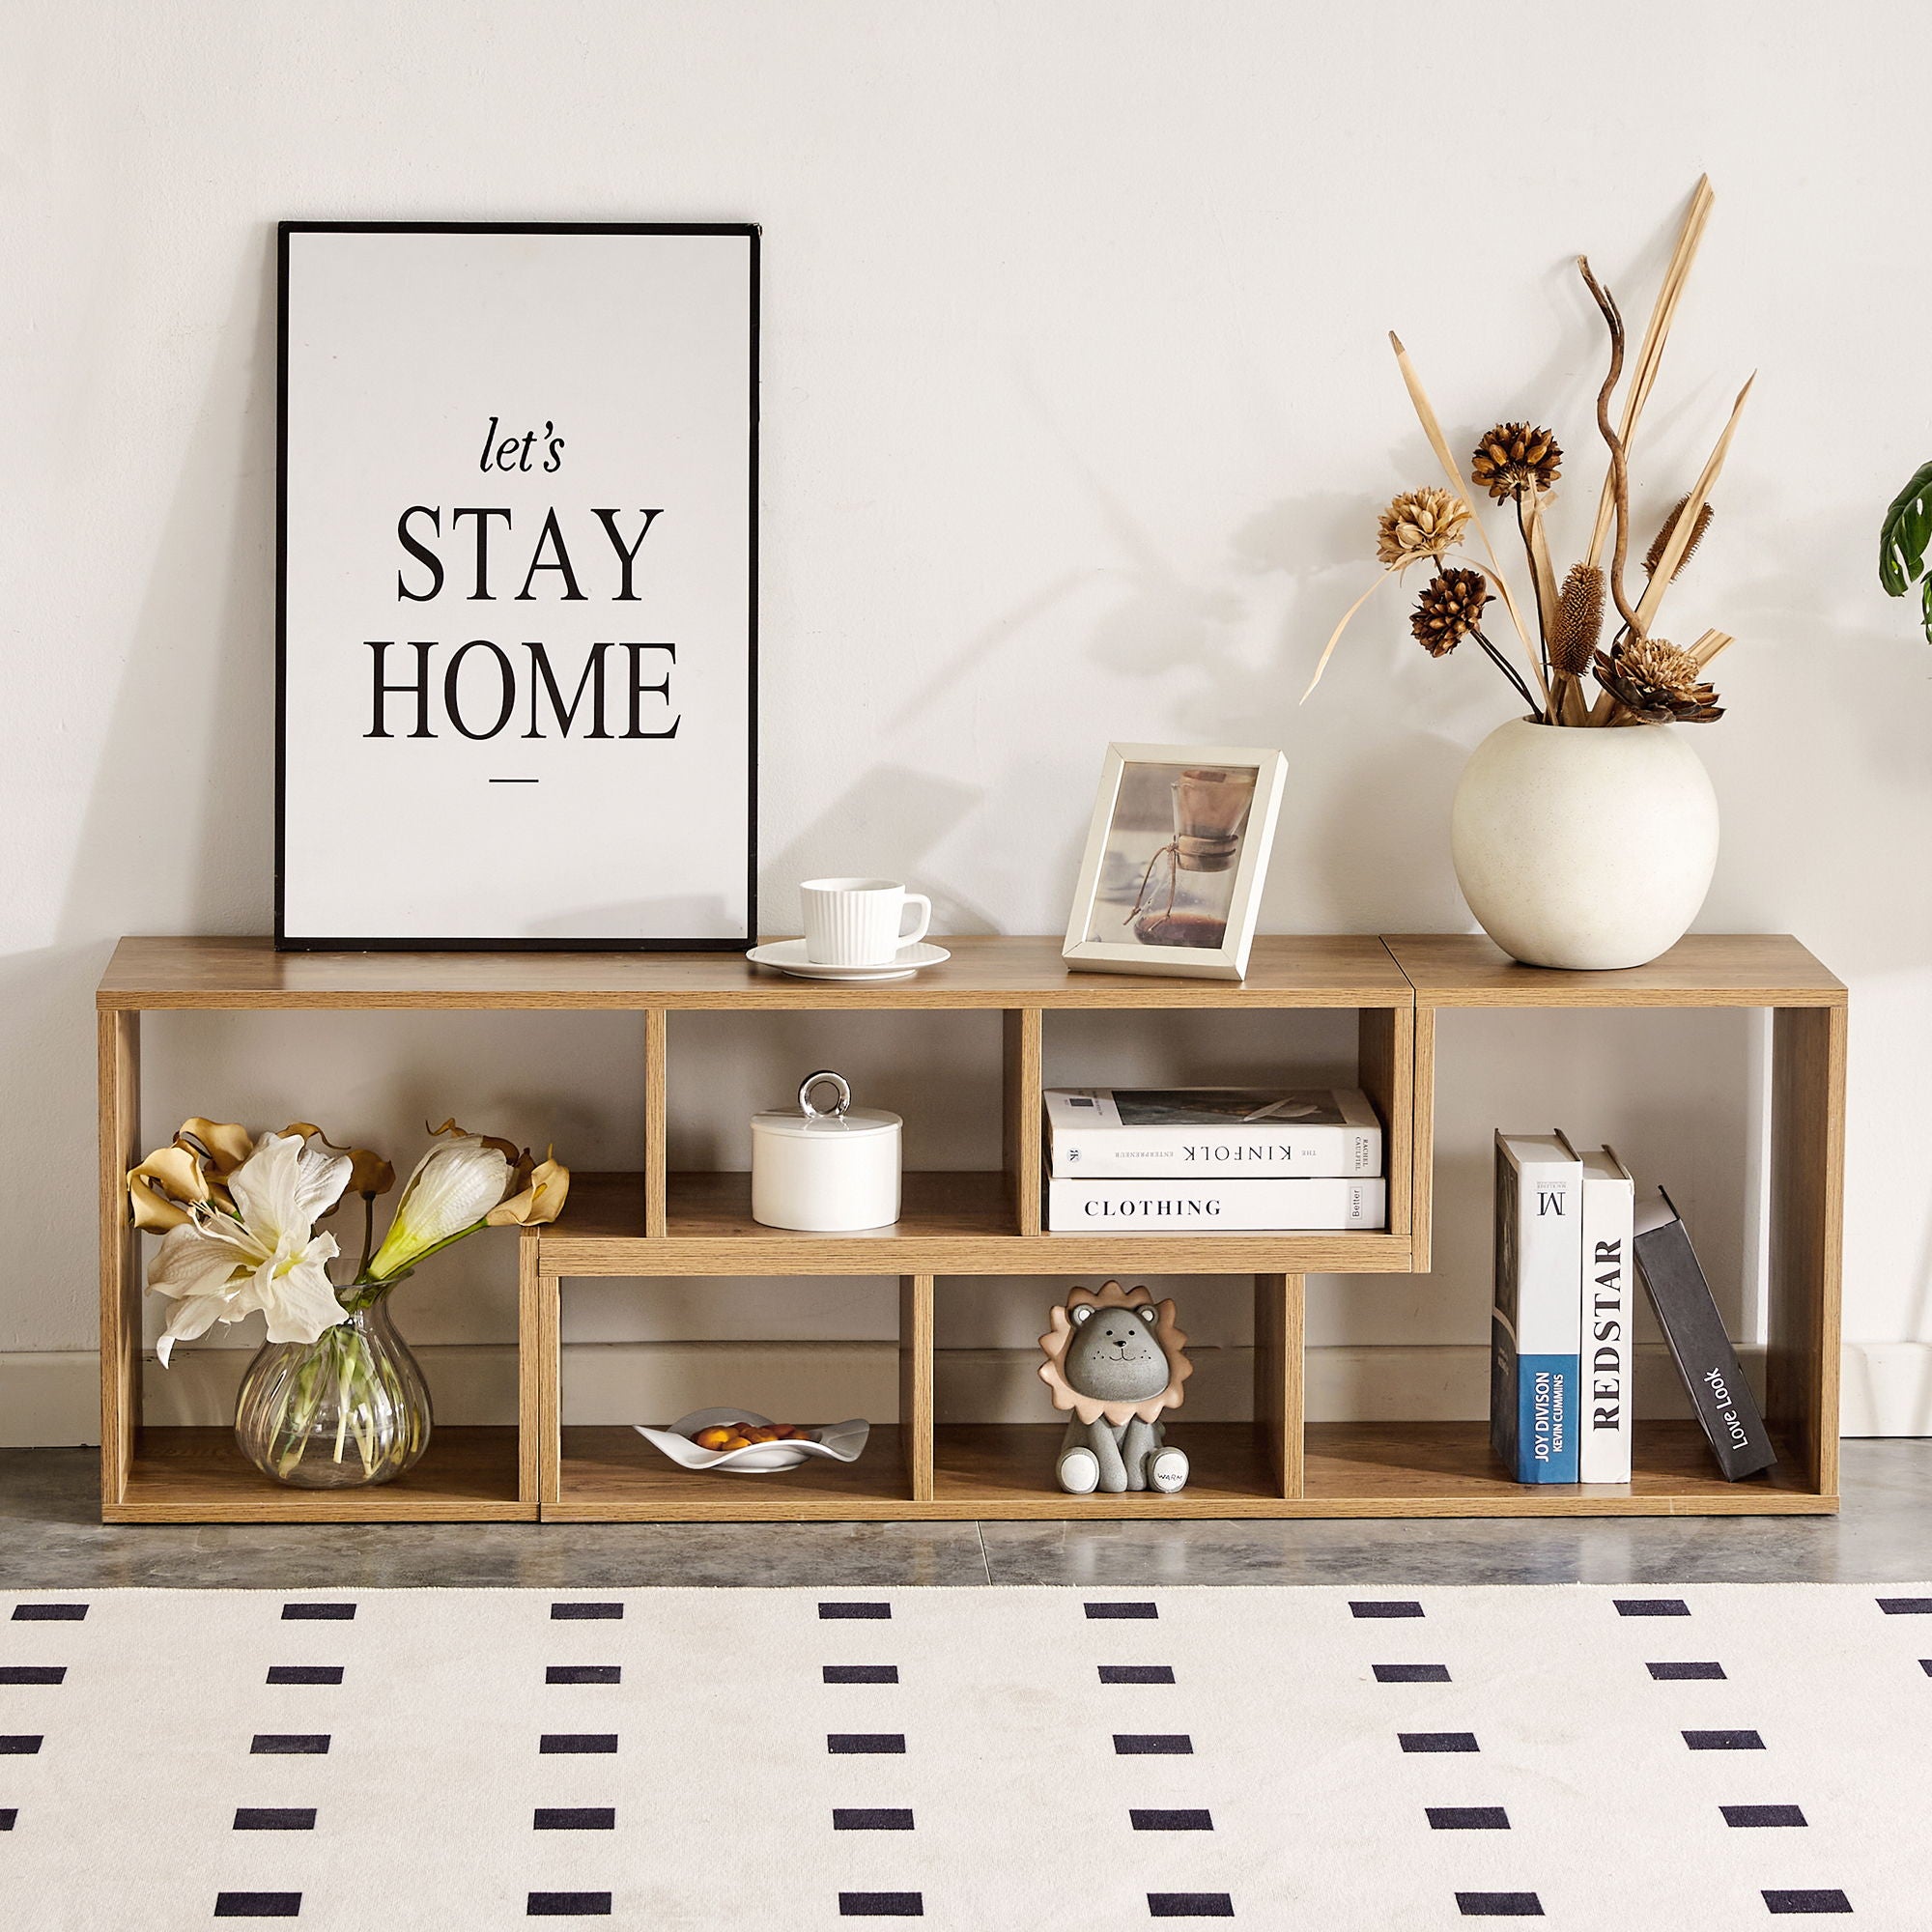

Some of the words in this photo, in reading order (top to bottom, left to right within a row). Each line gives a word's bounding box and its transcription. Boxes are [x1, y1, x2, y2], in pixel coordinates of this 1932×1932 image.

[479, 415, 565, 473] let's
[397, 505, 665, 603] STAY
[362, 639, 682, 741] HOME
[1181, 1145, 1293, 1162] KINFOLK
[1084, 1199, 1221, 1217] CLOTHING
[1351, 1189, 1360, 1217] Better
[1536, 1191, 1566, 1217] M
[1534, 1372, 1550, 1432] DIVISON
[1552, 1374, 1564, 1423] CUMMINS
[1703, 1367, 1732, 1410] Look
[1552, 1424, 1563, 1453] KEVIN
[1723, 1409, 1748, 1450] Love
[1534, 1435, 1549, 1463] JOY
[1157, 1473, 1183, 1482] WARM
